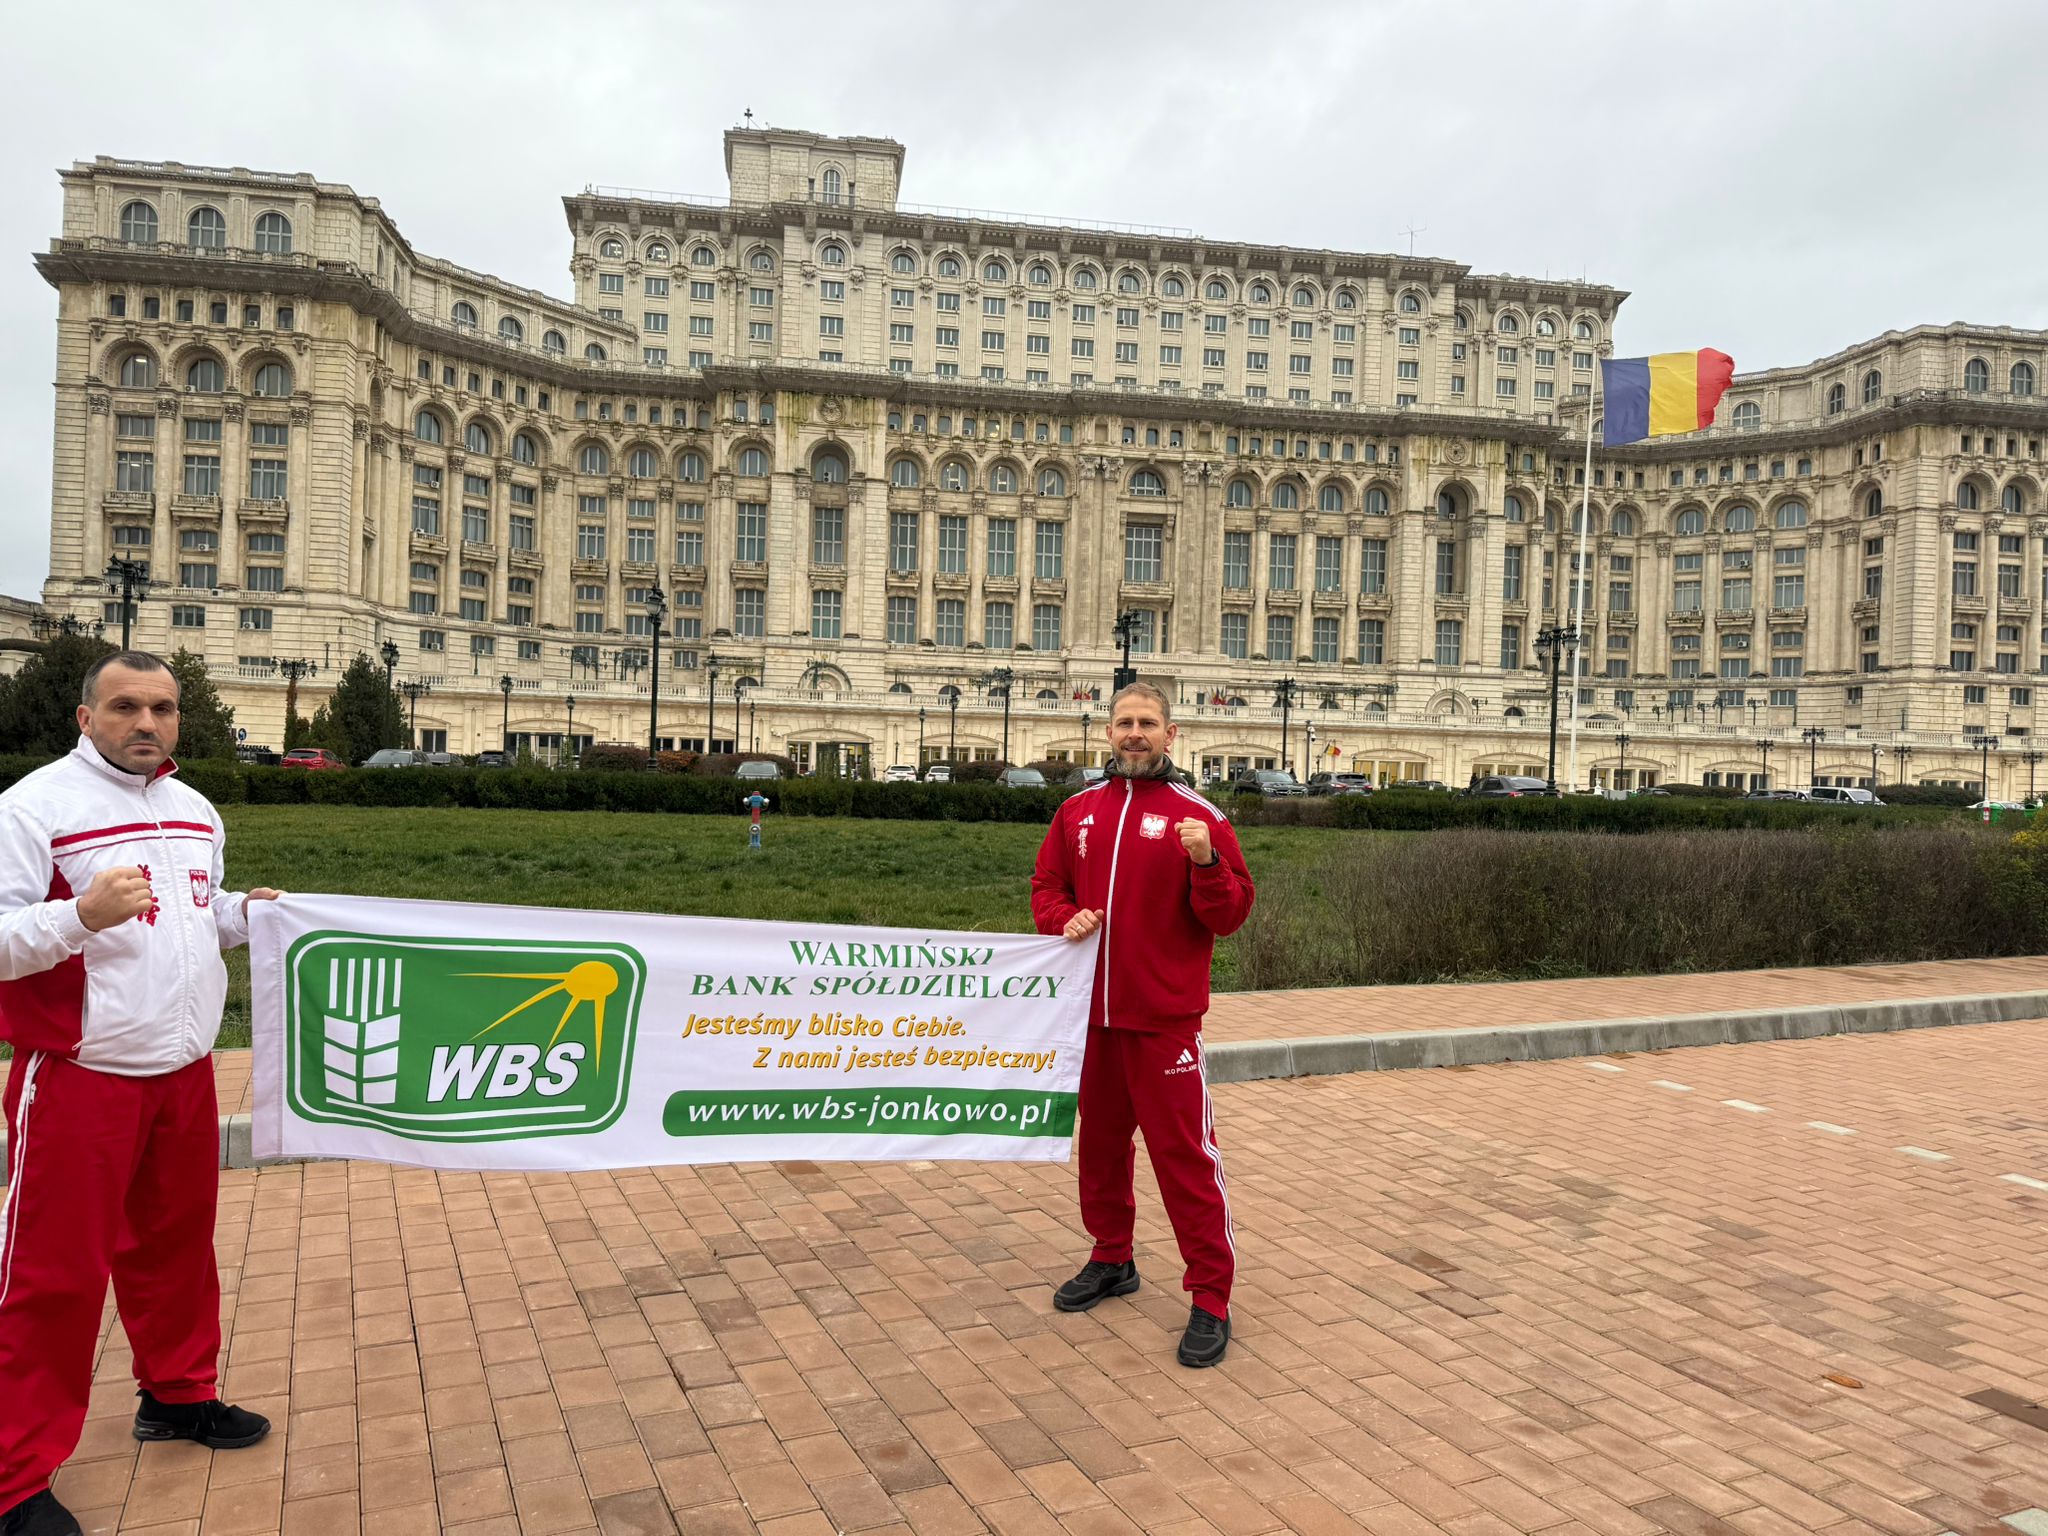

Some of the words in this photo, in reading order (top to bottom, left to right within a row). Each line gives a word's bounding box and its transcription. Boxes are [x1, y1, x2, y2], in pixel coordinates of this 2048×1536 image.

[789, 938, 995, 968] WARMIŃSKI
[689, 974, 797, 995] BANK
[809, 971, 1066, 998] SPÓŁDZIELCZY
[682, 1012, 801, 1040] Jesteśmy
[808, 1012, 884, 1036] blisko
[892, 1014, 967, 1037] Ciebie.
[426, 1040, 586, 1103] WBS
[752, 1046, 772, 1068] Z
[777, 1045, 841, 1068] nami
[844, 1045, 918, 1073] jesteś
[923, 1044, 1057, 1074] bezpieczny!
[688, 1094, 1052, 1131] www.wbs-jonkowo.pl
